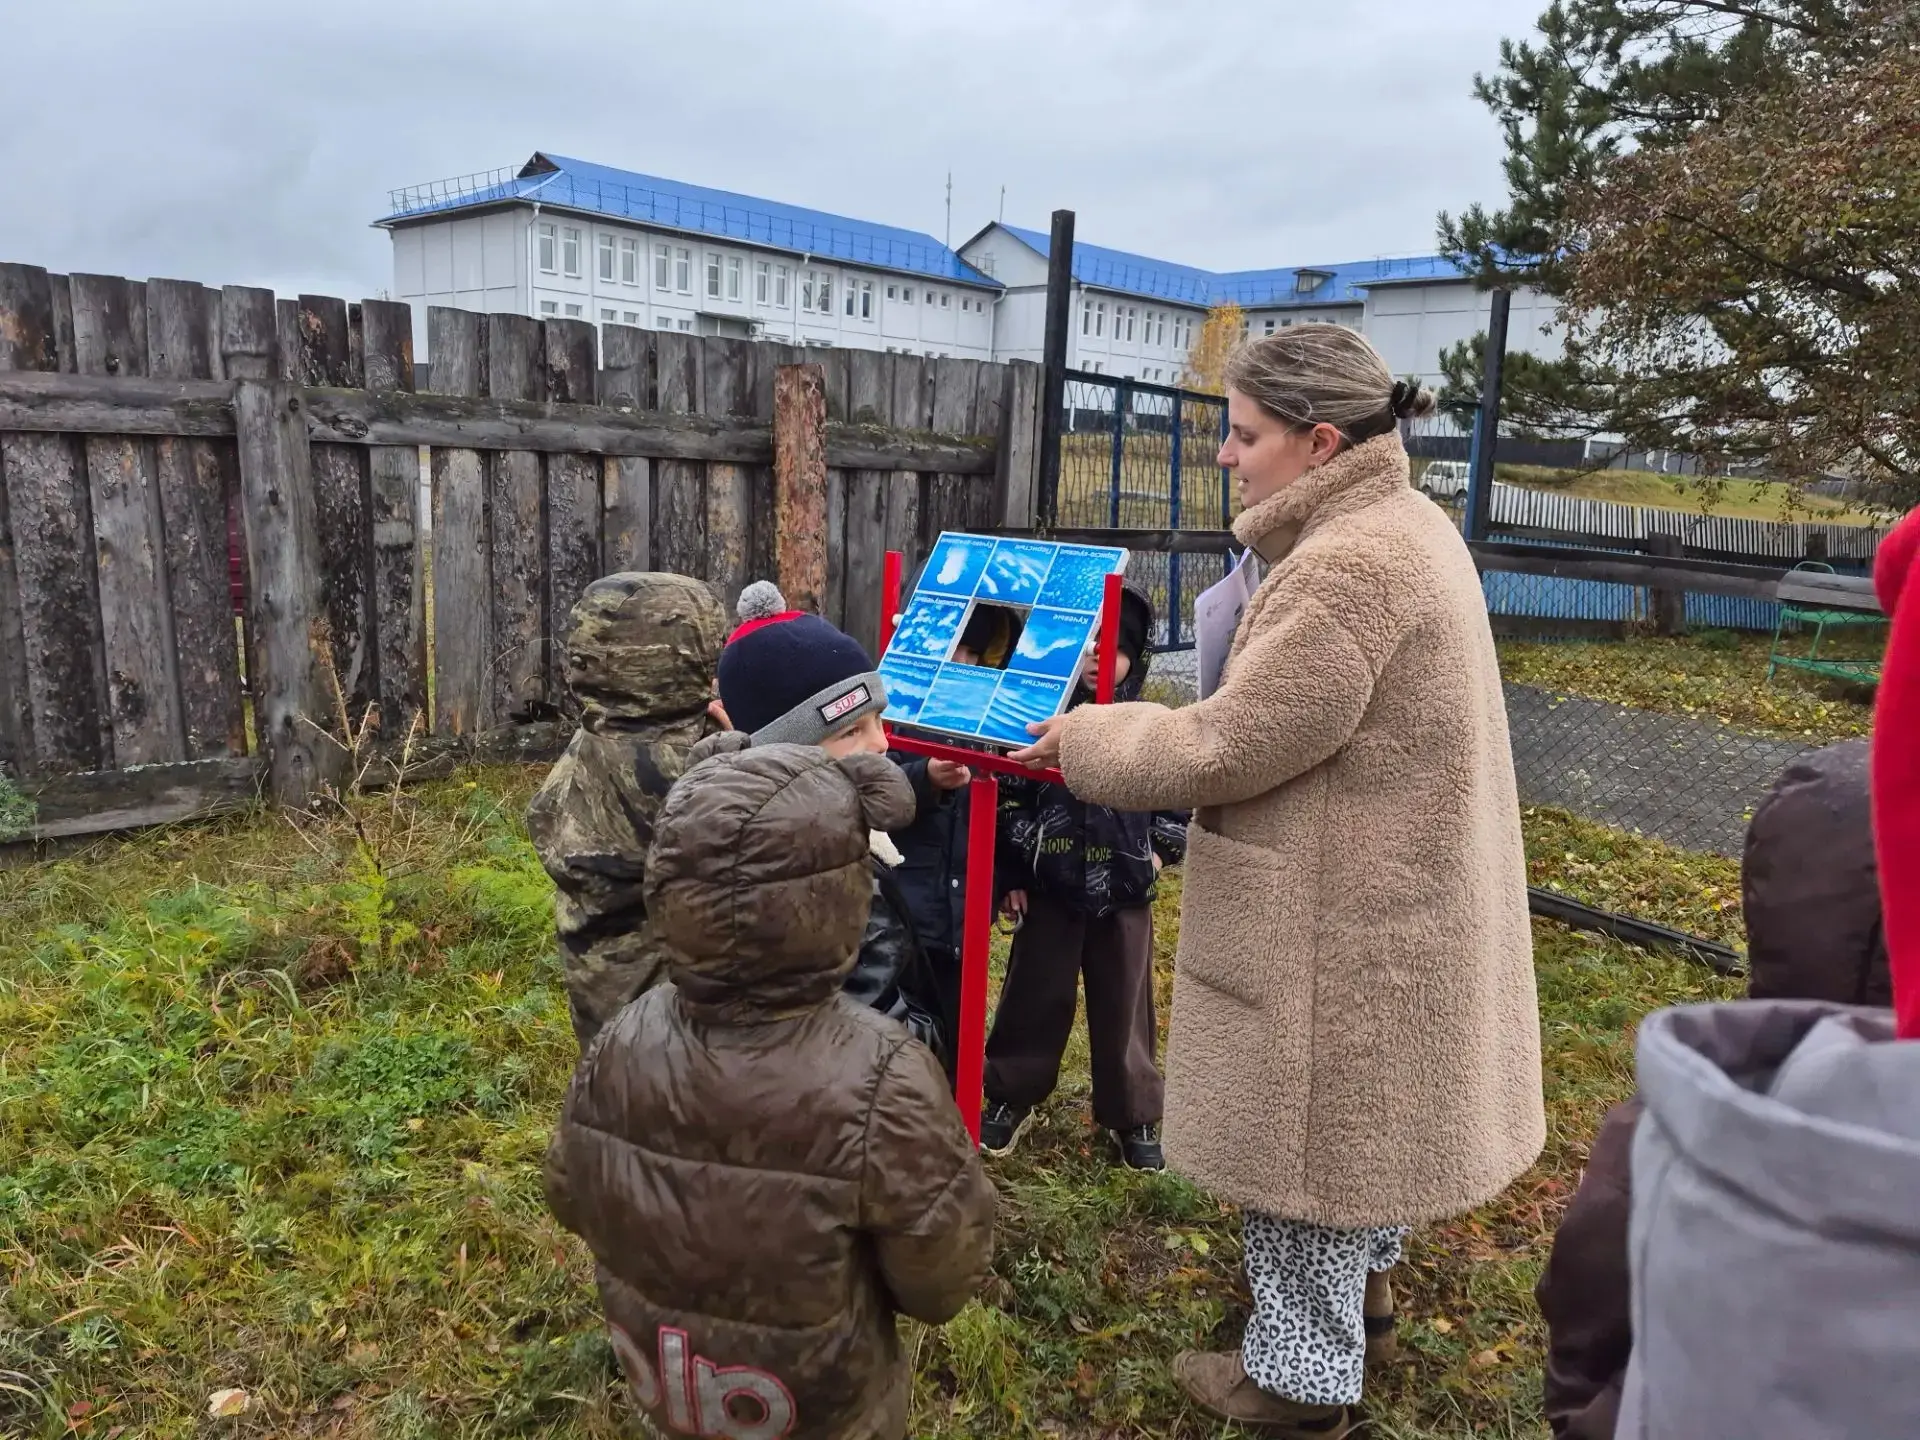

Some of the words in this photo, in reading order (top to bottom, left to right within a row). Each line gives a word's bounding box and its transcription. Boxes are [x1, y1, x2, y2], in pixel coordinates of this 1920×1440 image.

[1052, 613, 1089, 626] Кучевые
[1020, 678, 1061, 692] Слоистые
[834, 693, 857, 715] SUP
